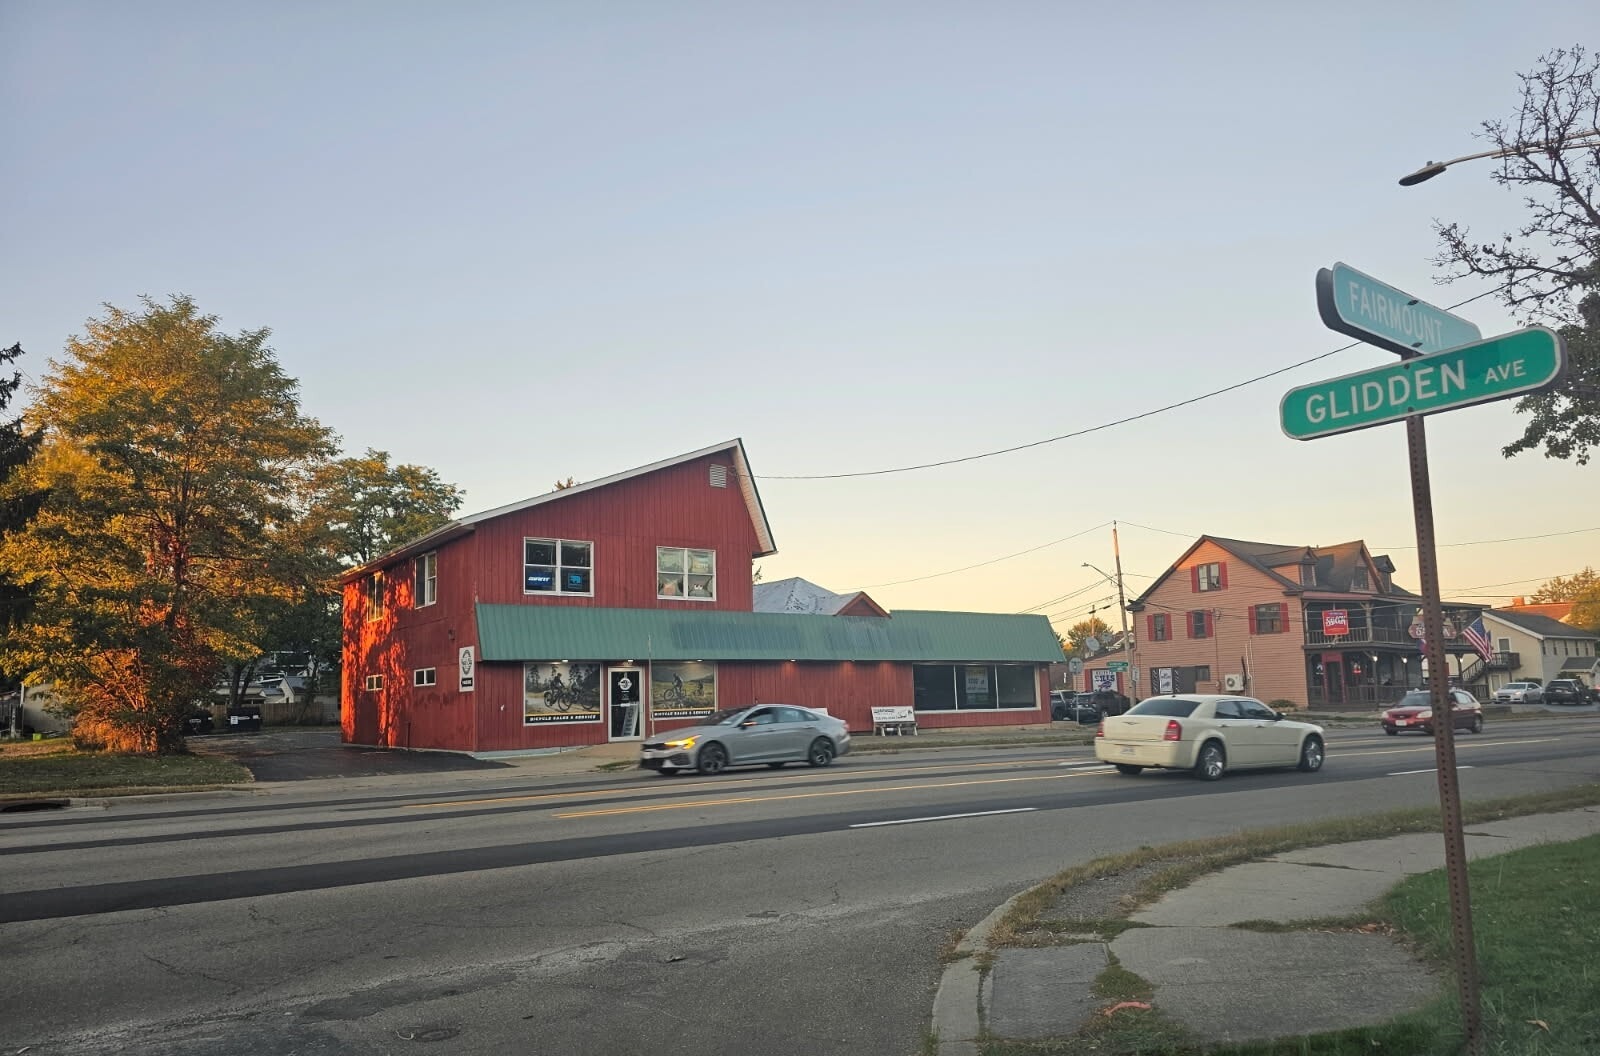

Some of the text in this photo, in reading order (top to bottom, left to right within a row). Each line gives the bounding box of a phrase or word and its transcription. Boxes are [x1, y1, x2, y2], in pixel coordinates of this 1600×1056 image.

[1349, 281, 1443, 347] FAIRMOUNT
[1305, 359, 1527, 424] GLIDDEN AVE
